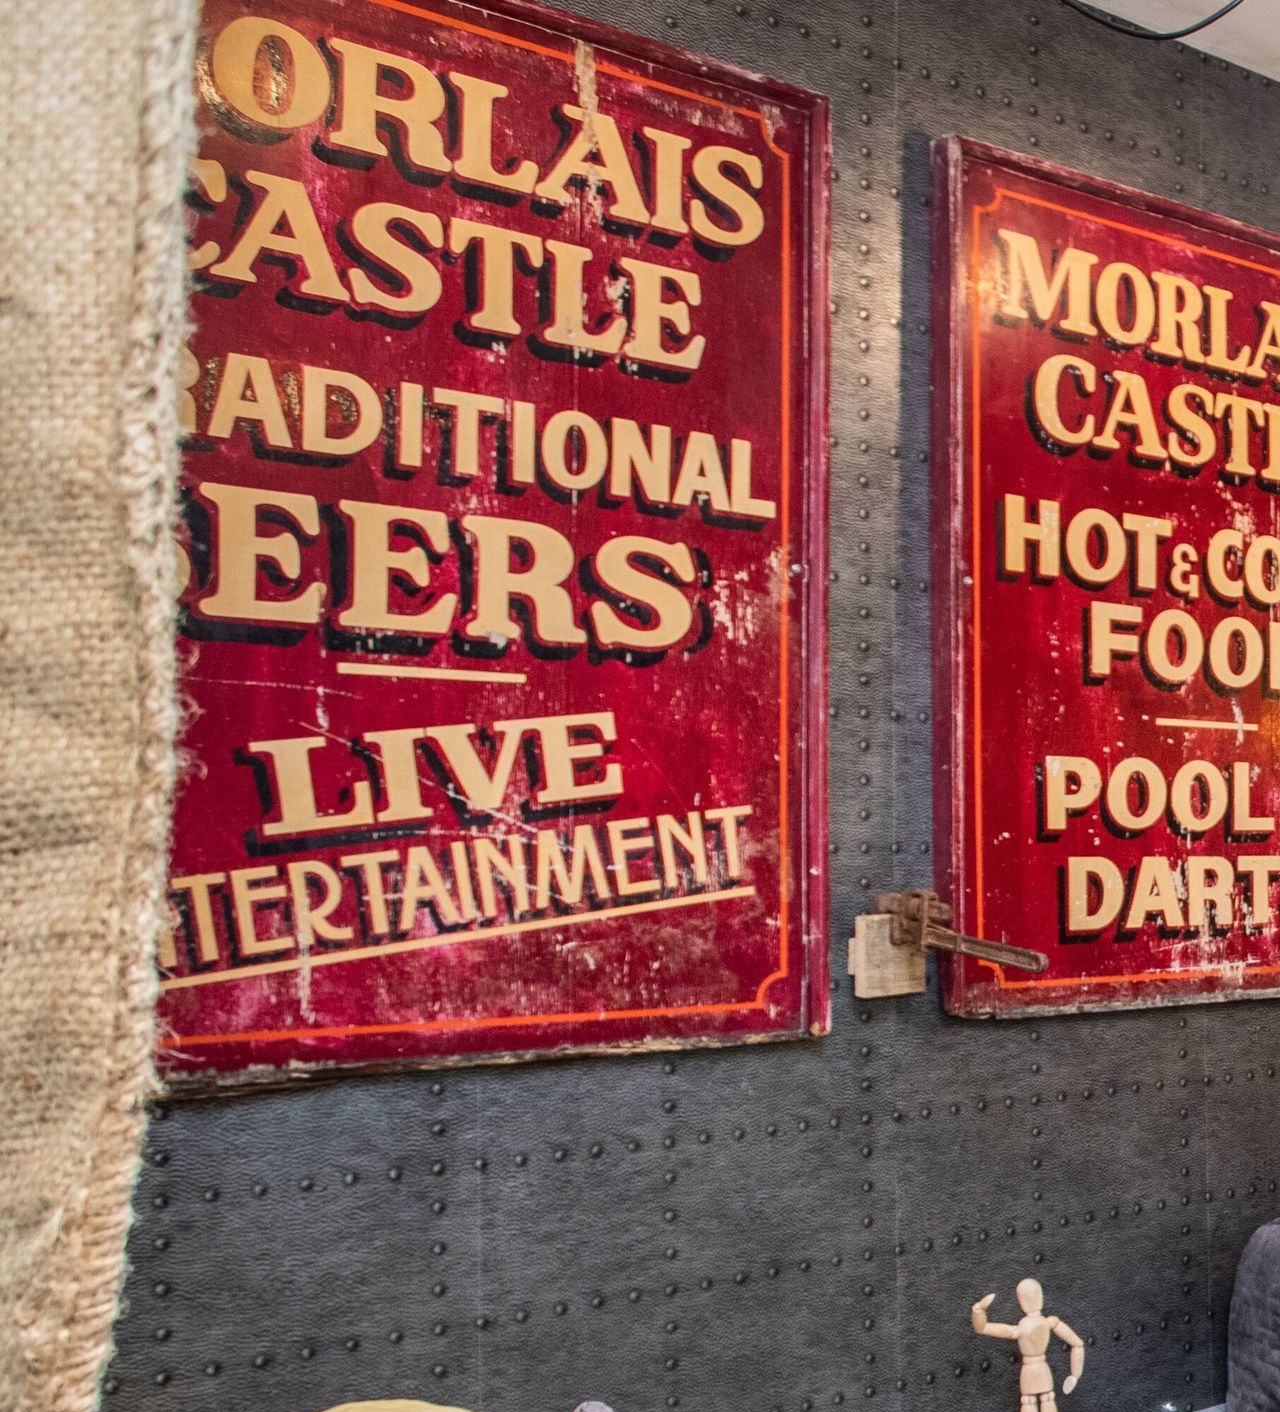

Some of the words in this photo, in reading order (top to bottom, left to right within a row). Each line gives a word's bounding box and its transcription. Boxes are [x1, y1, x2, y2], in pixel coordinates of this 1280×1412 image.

[213, 16, 765, 247] ORLAIS
[178, 347, 776, 519] ADITIONAL
[174, 482, 695, 649] EERS
[249, 712, 623, 836] LIVE
[1046, 756, 1275, 832] POOL
[157, 805, 753, 968] TERTAINMENT
